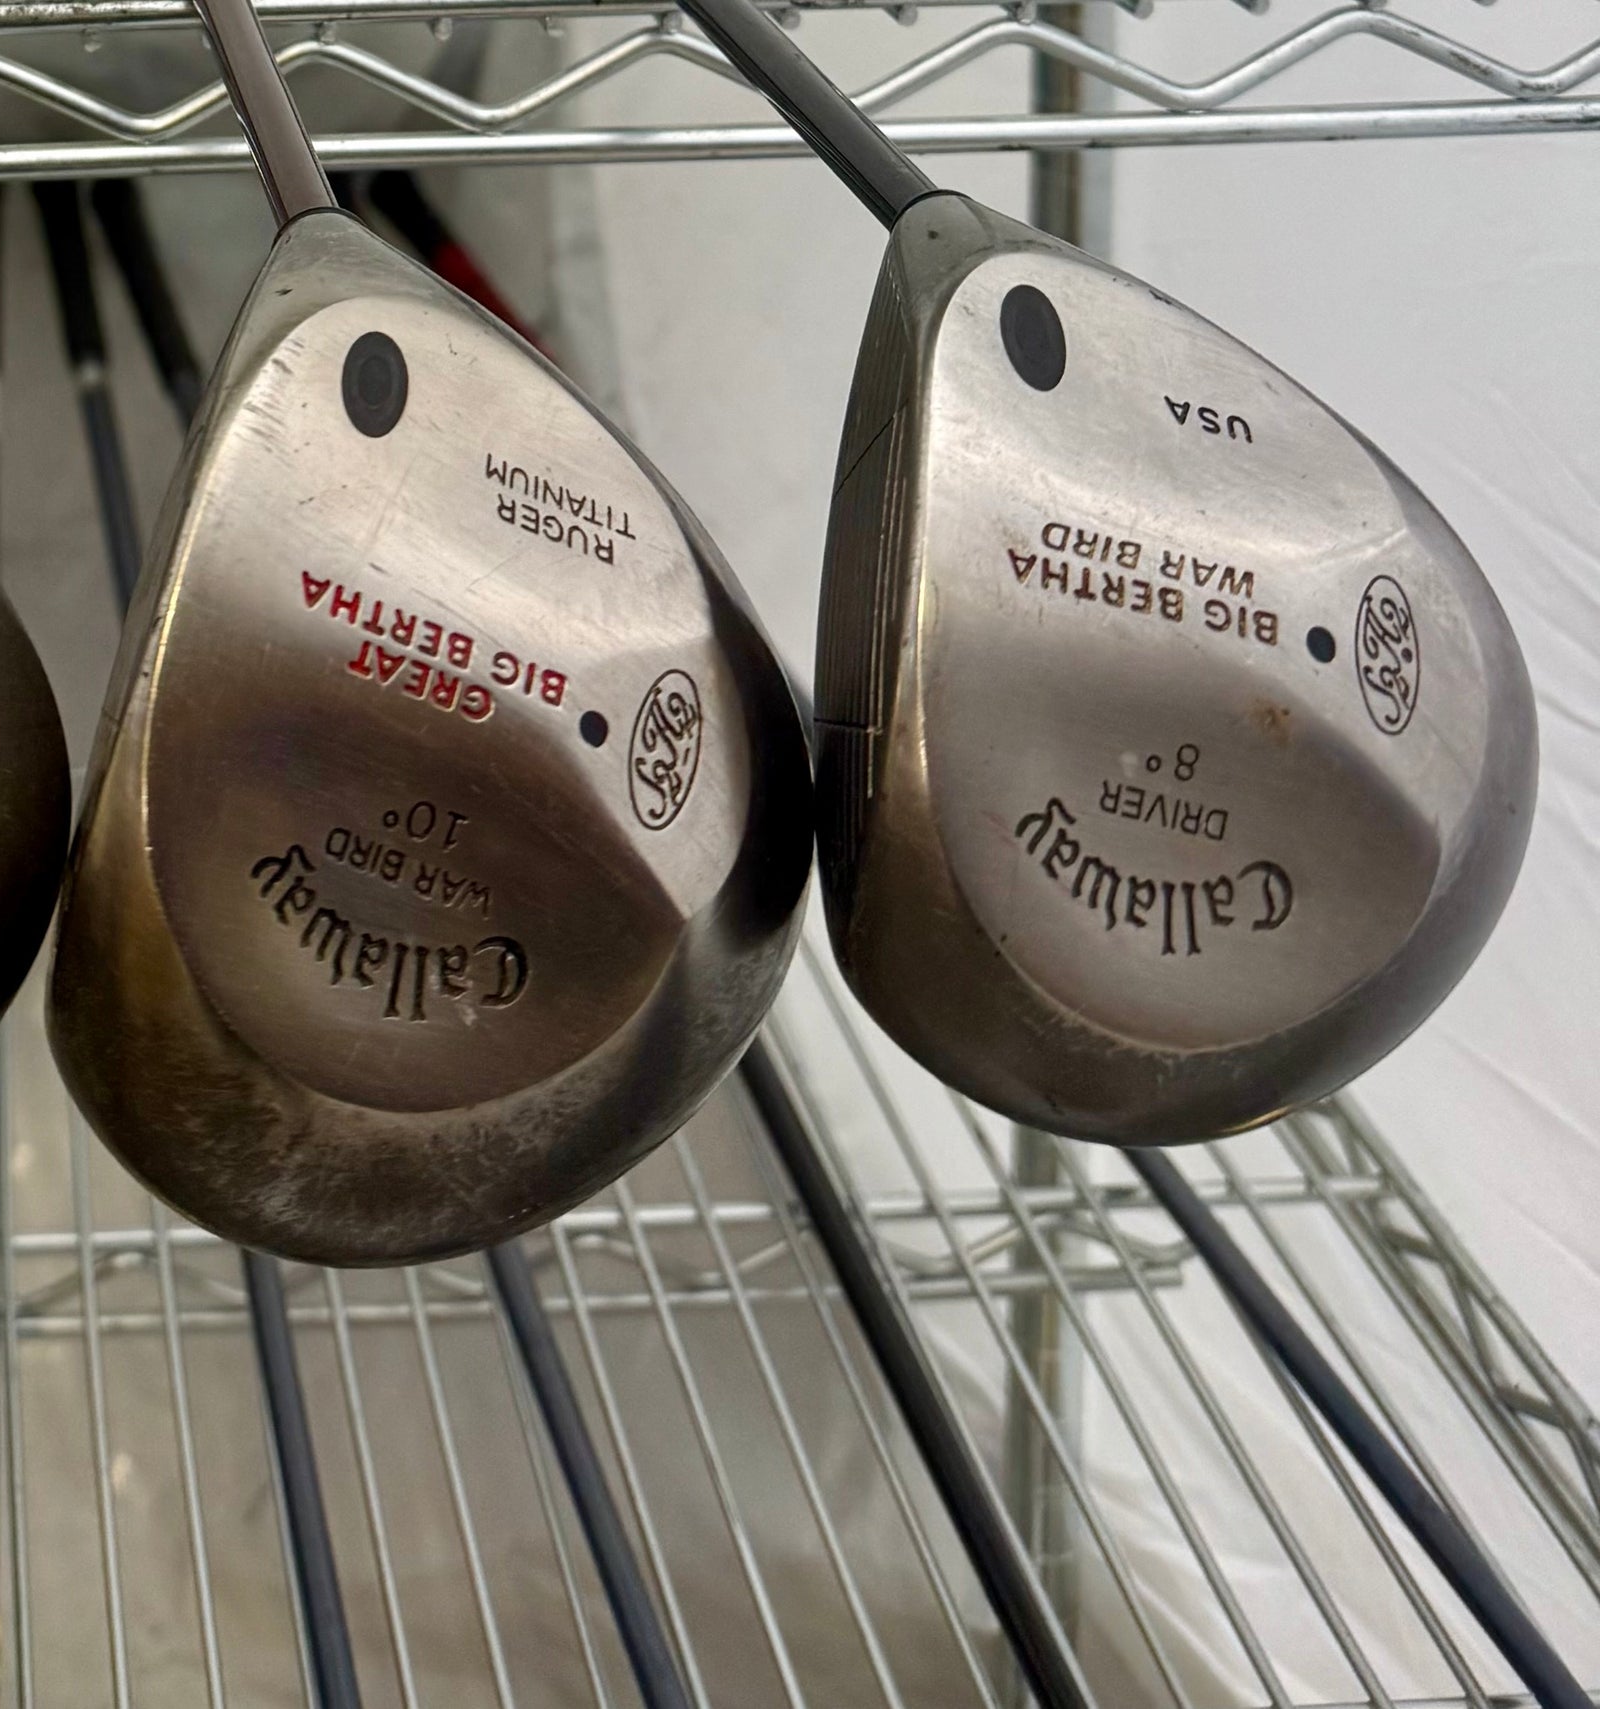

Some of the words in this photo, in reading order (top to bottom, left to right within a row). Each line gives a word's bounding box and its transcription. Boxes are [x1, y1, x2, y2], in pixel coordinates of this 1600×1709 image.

[1164, 395, 1253, 443] USA
[485, 453, 637, 540] TITANIUM
[497, 495, 615, 565] RUGER
[1041, 522, 1141, 567] BIRD
[1006, 548, 1183, 622] BERTHA
[1159, 550, 1255, 596] WAR
[301, 571, 474, 669] BERTHA
[1204, 601, 1278, 645] BIG
[347, 640, 496, 722] GREAT
[492, 650, 568, 708] BIG
[1099, 779, 1229, 841] DRIVER
[325, 827, 401, 882] BIRD
[1015, 797, 1294, 956] Callaway
[416, 864, 491, 917] WAR
[250, 844, 529, 1022] Callaway
